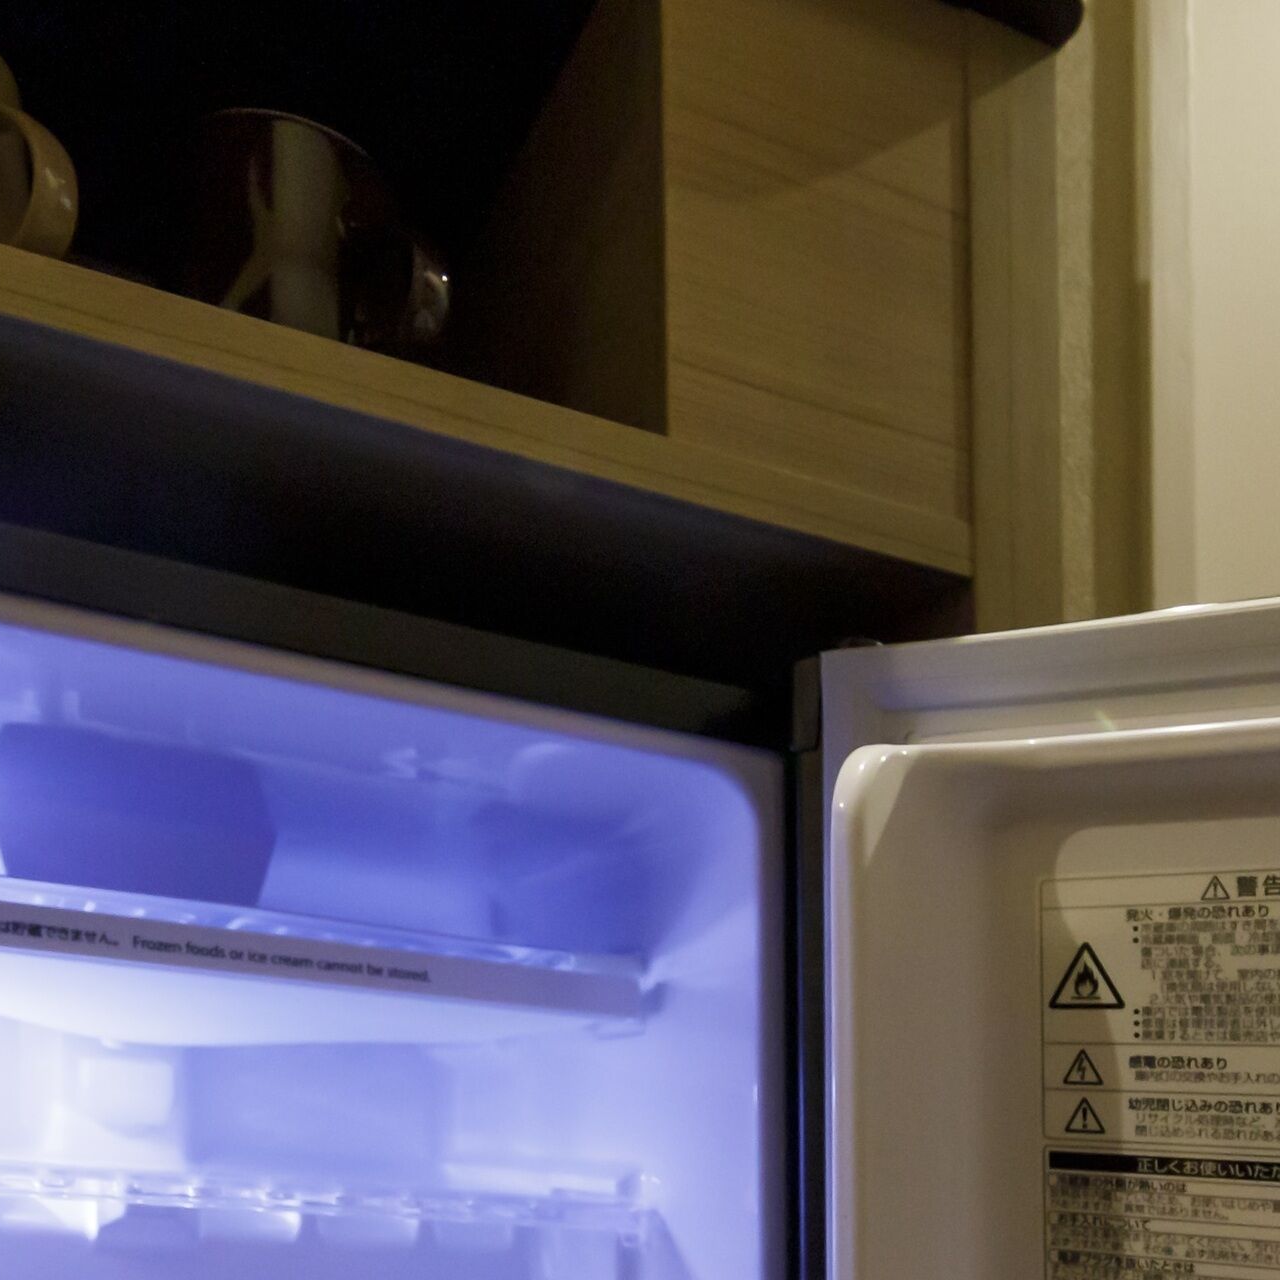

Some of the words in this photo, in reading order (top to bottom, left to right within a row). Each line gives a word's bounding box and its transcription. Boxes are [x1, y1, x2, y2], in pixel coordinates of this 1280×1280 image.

[132, 935, 182, 954] Frozen
[186, 941, 225, 959] foods
[229, 949, 243, 960] or
[247, 950, 267, 964] ice
[271, 954, 313, 968] cream
[316, 958, 364, 975] cannot
[367, 963, 384, 977] be
[387, 967, 430, 983] stored.
